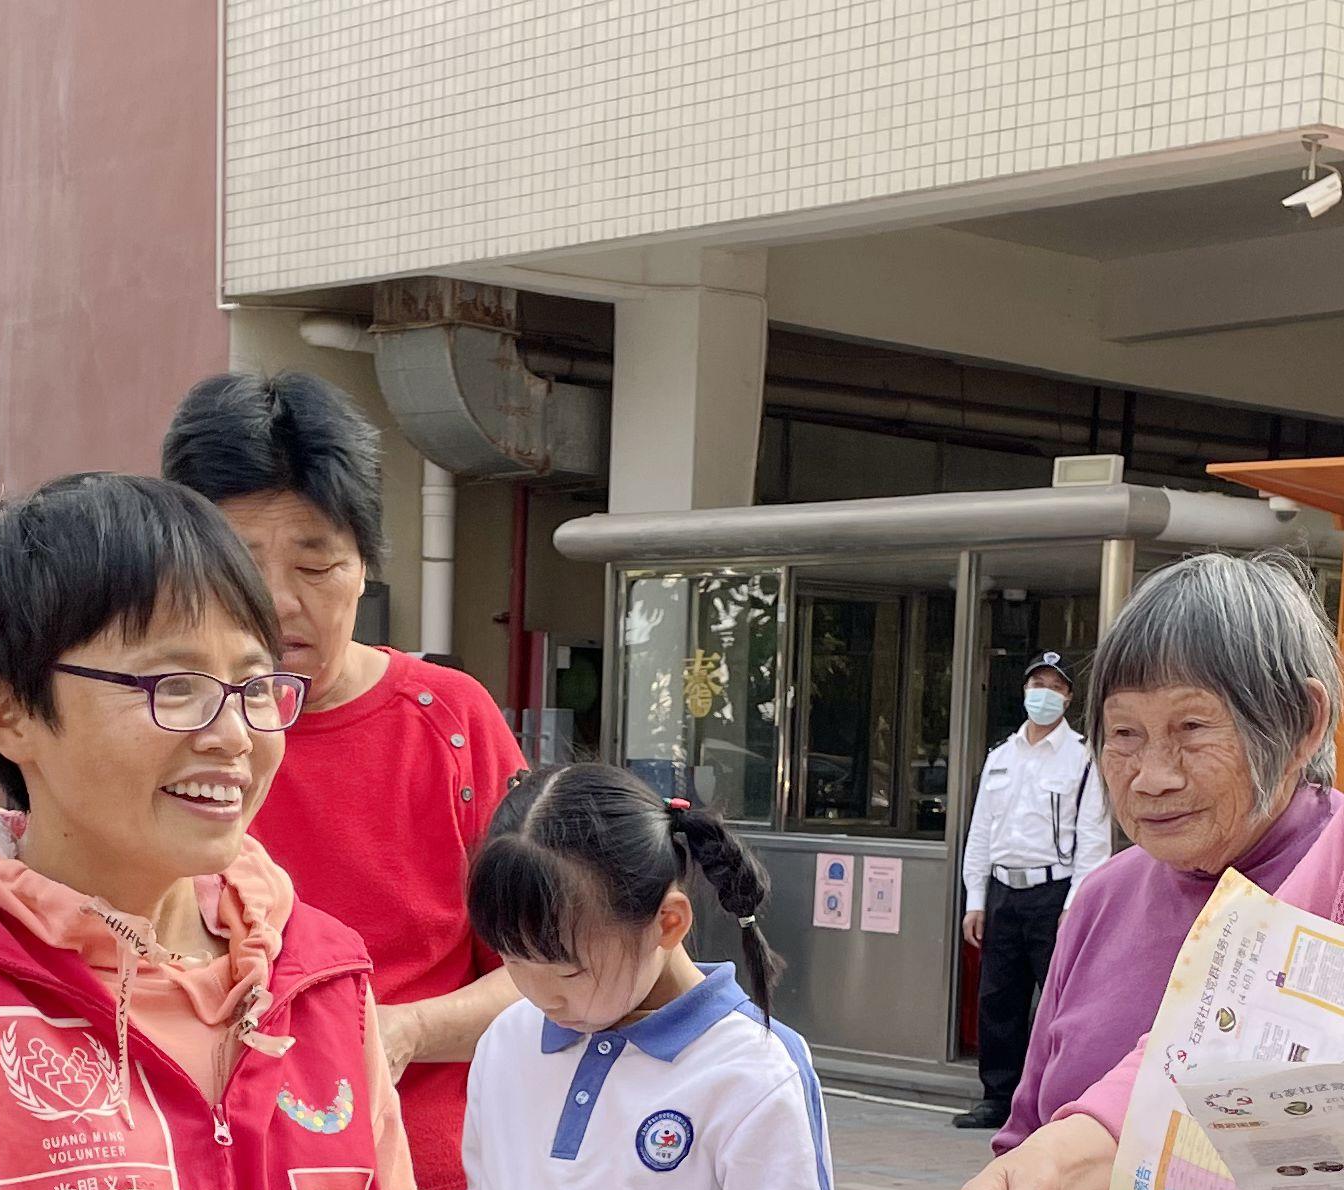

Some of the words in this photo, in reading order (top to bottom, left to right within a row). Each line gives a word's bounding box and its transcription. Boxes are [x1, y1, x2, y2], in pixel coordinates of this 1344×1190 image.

[42, 1132, 87, 1150] GUANG
[92, 1131, 125, 1144] MING
[48, 1146, 127, 1164] VOLUNTEER
